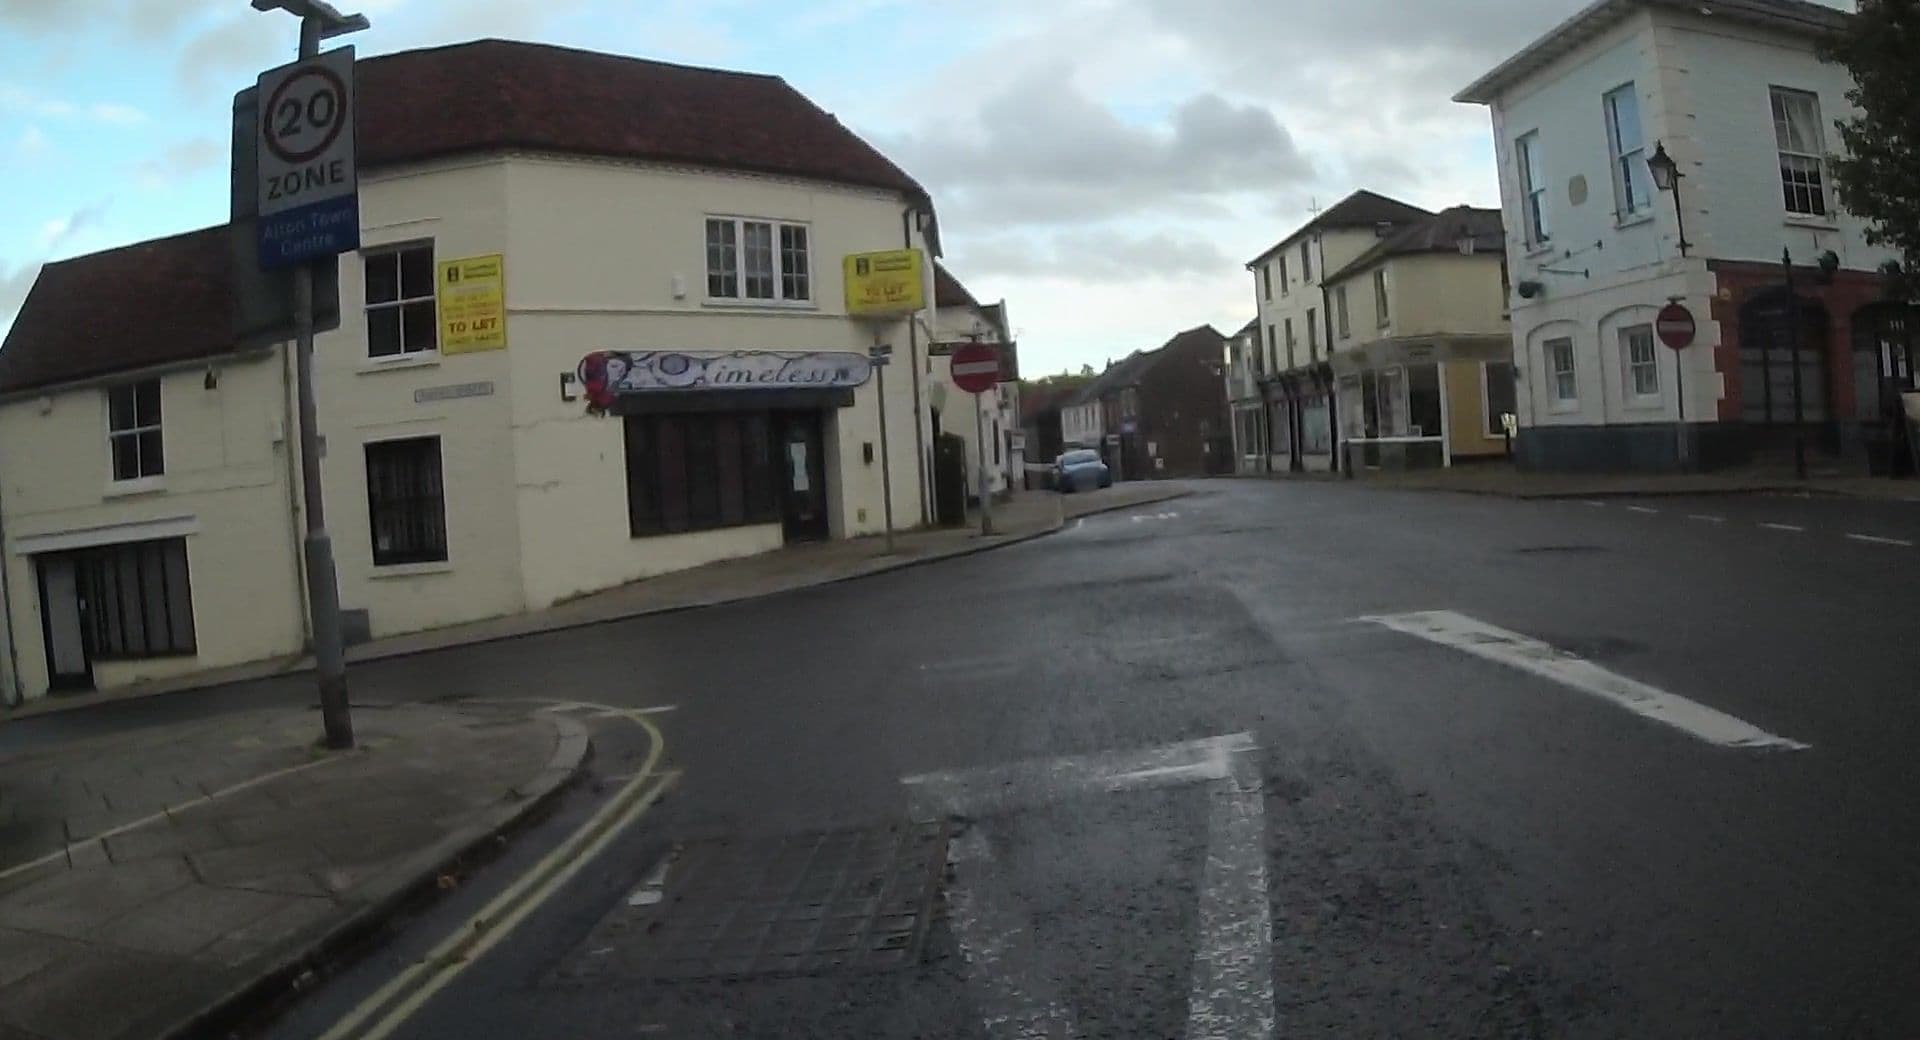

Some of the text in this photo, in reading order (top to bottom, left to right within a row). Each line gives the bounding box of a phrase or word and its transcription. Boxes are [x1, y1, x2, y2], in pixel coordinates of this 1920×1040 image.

[278, 88, 335, 138] 20
[267, 160, 345, 201] ZONE
[263, 209, 350, 240] Alton Town
[280, 232, 333, 255] Centre
[448, 317, 497, 334] TO LET
